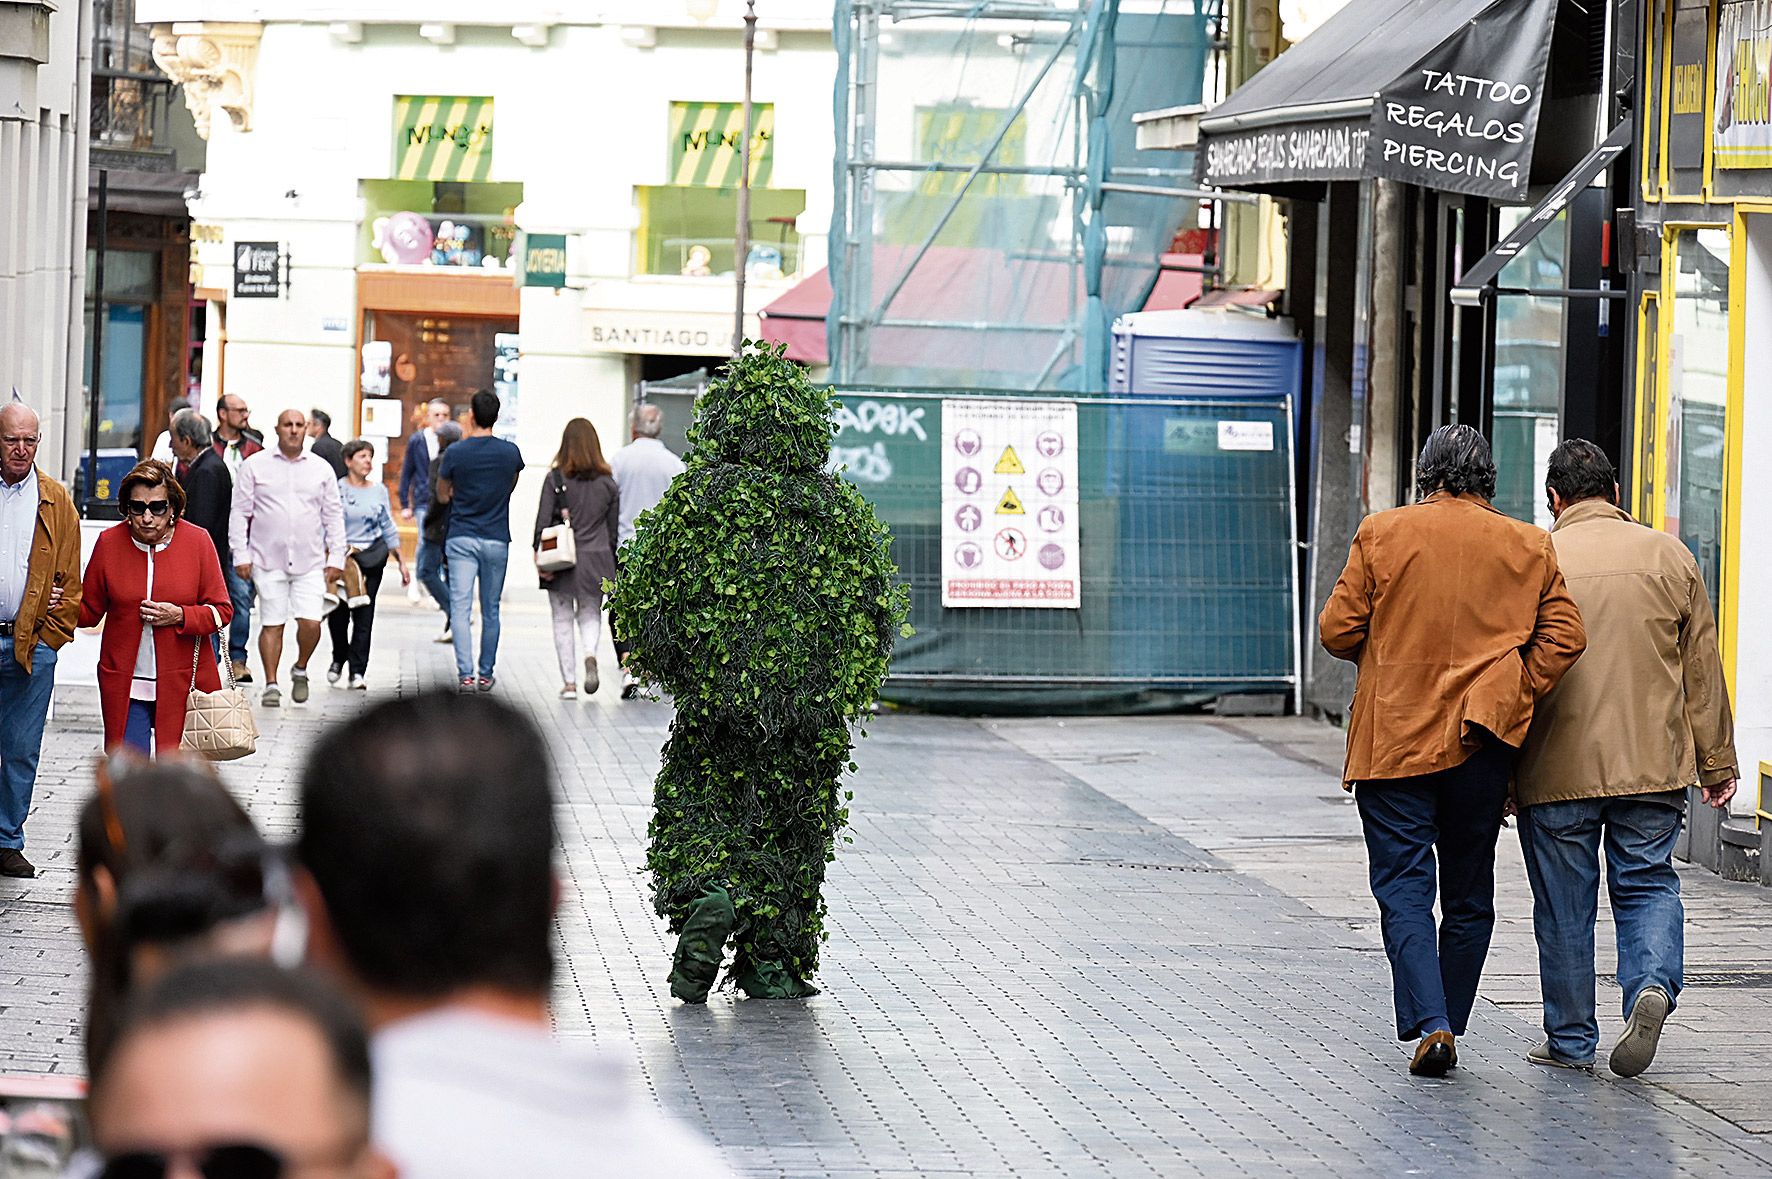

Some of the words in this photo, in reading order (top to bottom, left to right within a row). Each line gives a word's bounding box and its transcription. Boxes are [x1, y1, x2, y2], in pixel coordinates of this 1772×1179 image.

[1421, 69, 1532, 106] TATTOO
[1385, 102, 1526, 145] REGALOS
[1382, 138, 1520, 188] PIERCING
[592, 326, 709, 346] SANTIAGO
